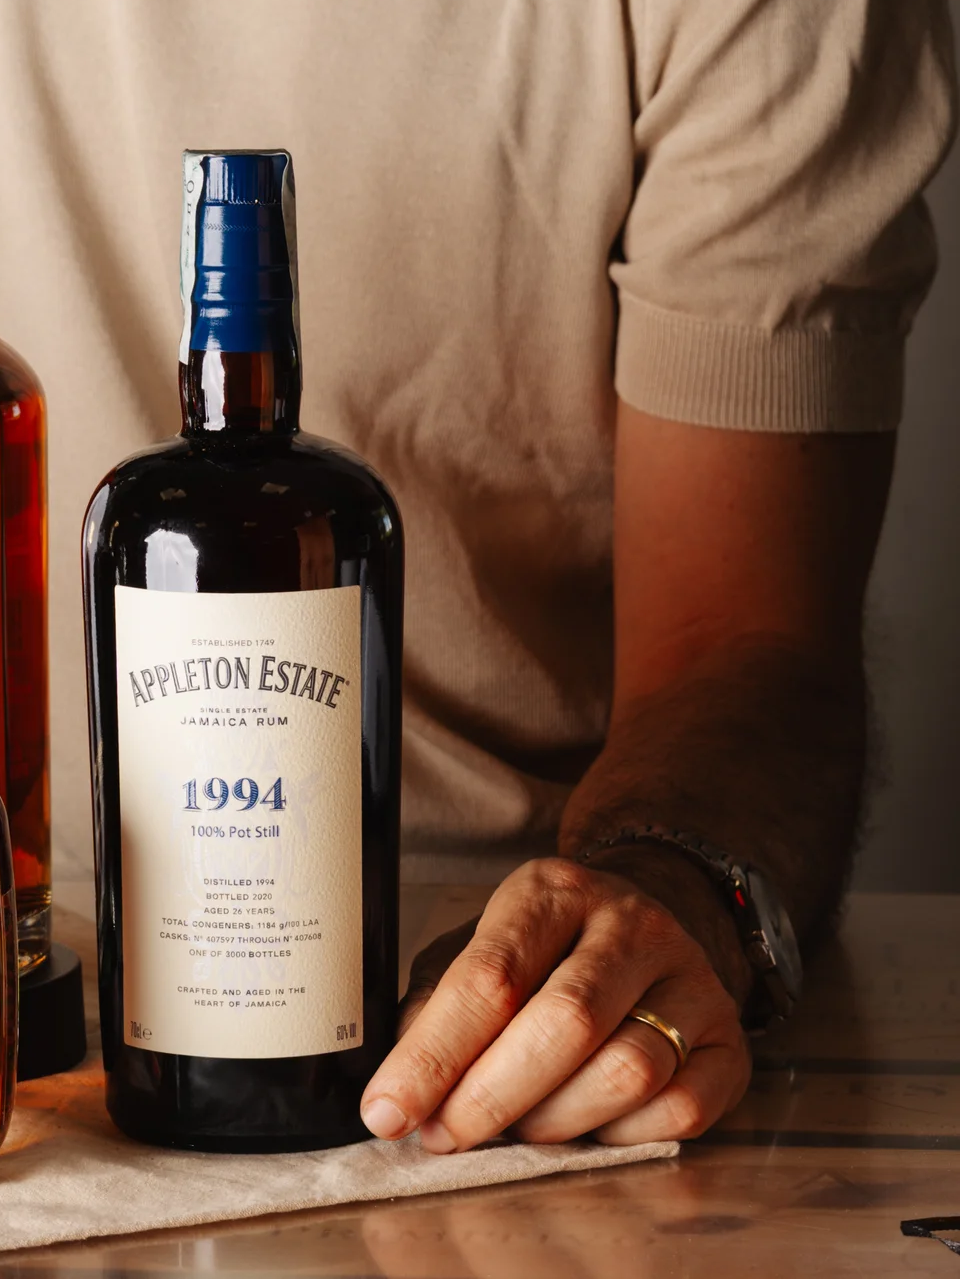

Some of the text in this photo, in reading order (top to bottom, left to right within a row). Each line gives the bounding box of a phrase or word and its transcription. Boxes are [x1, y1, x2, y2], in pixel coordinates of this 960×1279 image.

[192, 639, 253, 647] ESTABLISHED
[129, 655, 345, 709] APPLETON ESTATE
[180, 716, 289, 727] JAMAICA RUM
[182, 776, 287, 812] 1994
[190, 825, 280, 838] 100% Pot Still
[203, 878, 275, 886] DISTILLED 1994
[206, 892, 273, 901] BOTTLED 2020
[204, 907, 275, 915] AGED 26 YEARS
[161, 917, 189, 927] TOTAL
[192, 920, 254, 930] CONGENERS:
[302, 919, 319, 927] LAA
[294, 932, 322, 942] 407608
[189, 949, 292, 958] ONE OF 3000 BOTTLES
[177, 985, 306, 996] CRAFTED AND AGED IN THE
[194, 999, 287, 1008] HEART OF JAMAICA
